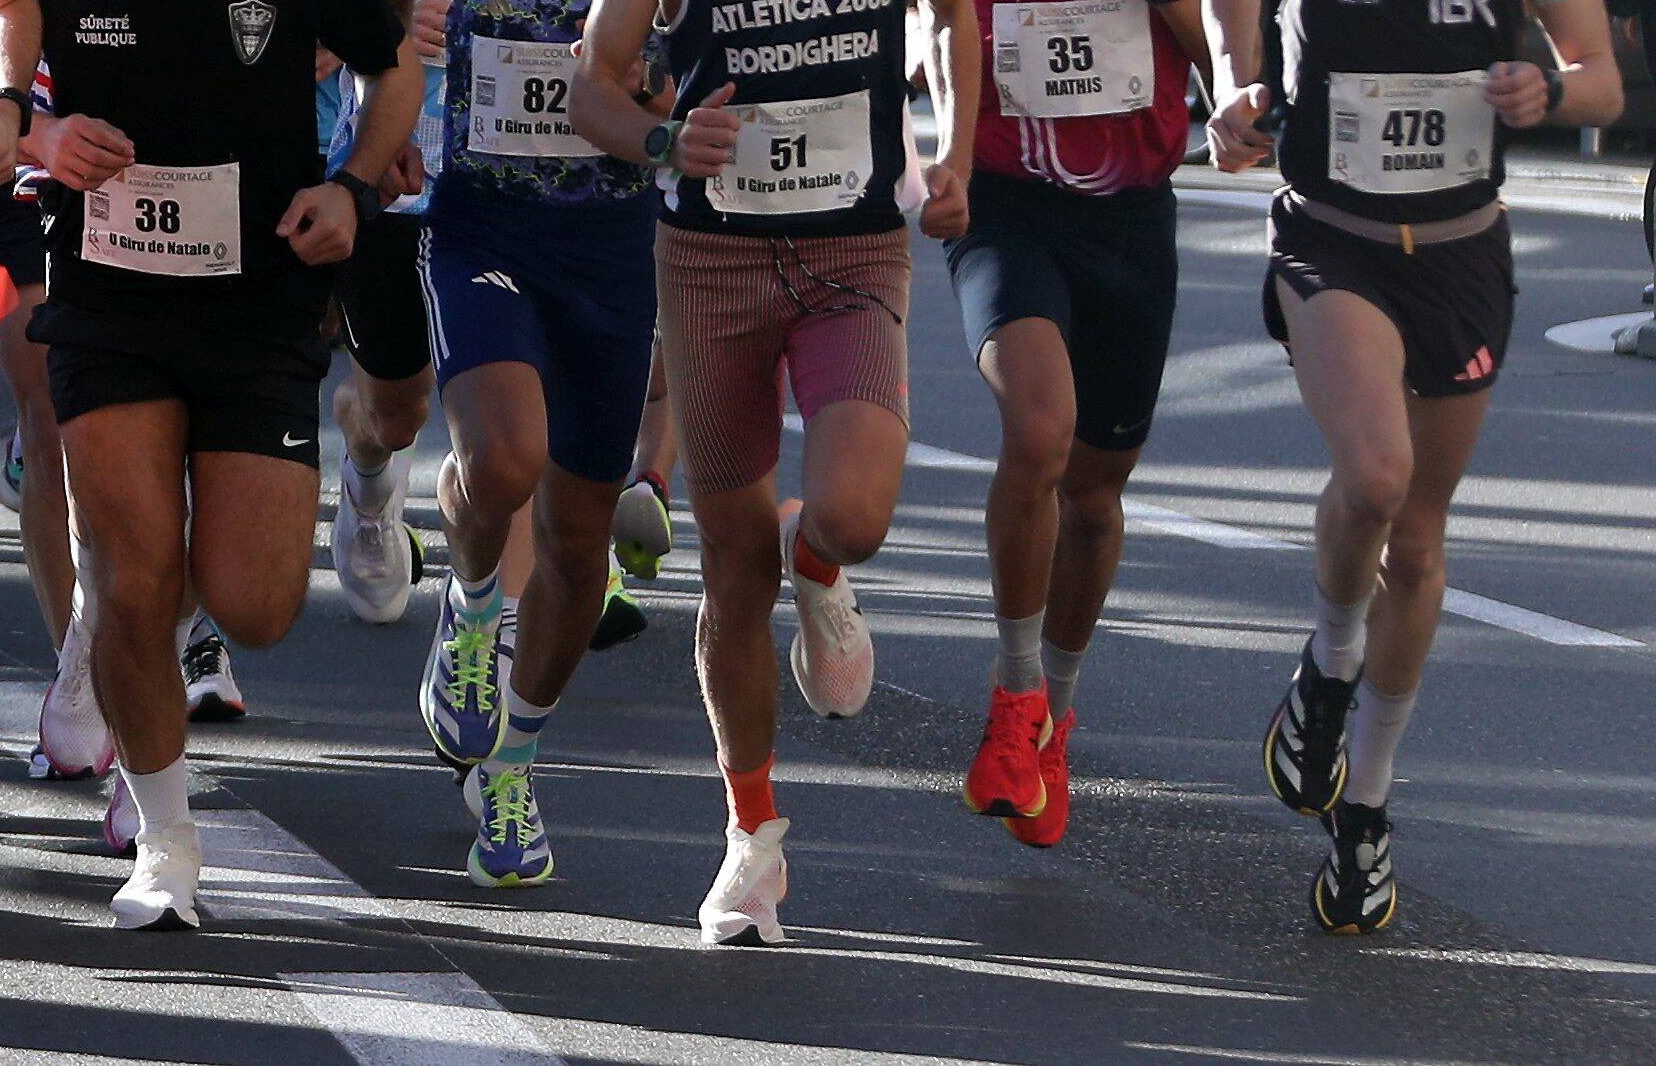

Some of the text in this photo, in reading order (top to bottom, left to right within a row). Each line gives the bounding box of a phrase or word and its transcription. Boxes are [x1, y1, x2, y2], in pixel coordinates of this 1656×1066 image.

[79, 14, 130, 30] SÛRETÉ
[75, 32, 137, 47] PUBLIQUE
[724, 29, 879, 74] BORDIGHERA
[1047, 35, 1094, 74] 35
[523, 77, 568, 114] 82
[1045, 76, 1102, 97] MATHIS
[495, 119, 503, 133] U
[505, 120, 532, 135] Giru
[534, 121, 551, 135] de
[1382, 109, 1445, 147] 478
[770, 133, 807, 172] 51
[1382, 153, 1444, 171] ROMAIN
[737, 172, 842, 193] U Giru de Natale
[135, 197, 181, 234] 38
[109, 233, 211, 256] U Giru de Natale
